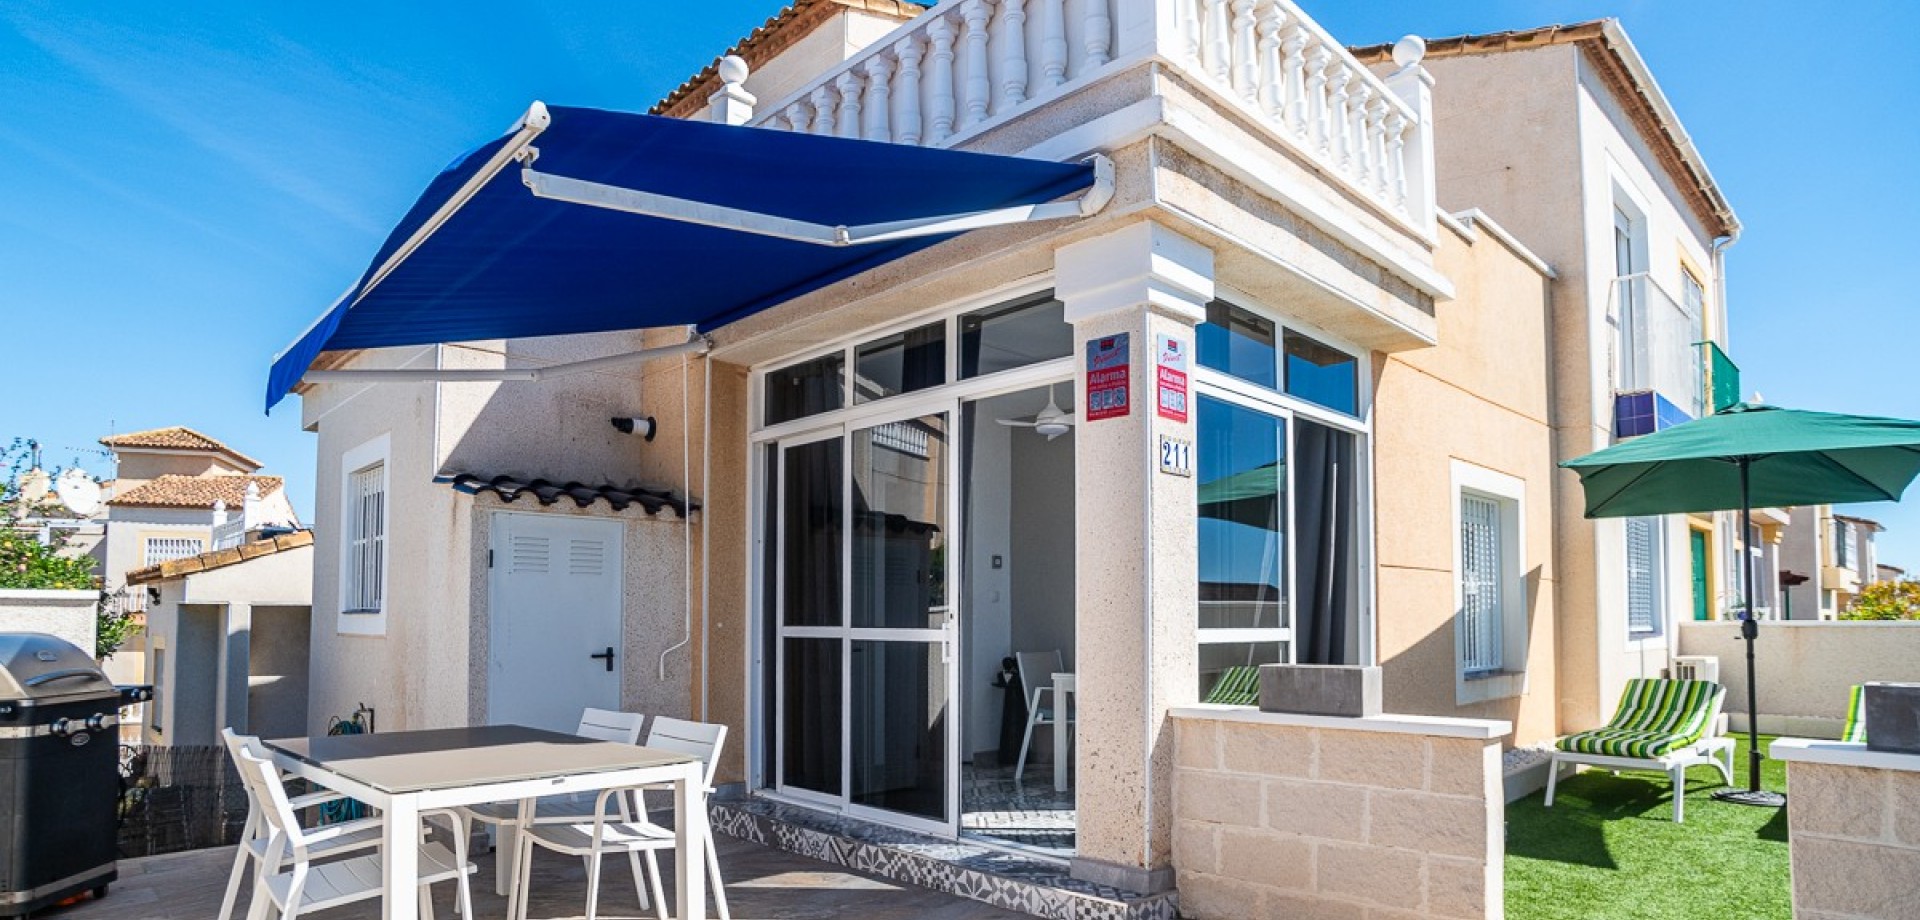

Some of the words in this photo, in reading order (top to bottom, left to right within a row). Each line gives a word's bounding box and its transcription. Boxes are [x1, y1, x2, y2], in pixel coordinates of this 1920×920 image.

[1090, 369, 1126, 385] Alarma
[1159, 368, 1185, 384] Alarma
[1163, 441, 1187, 469] 211
